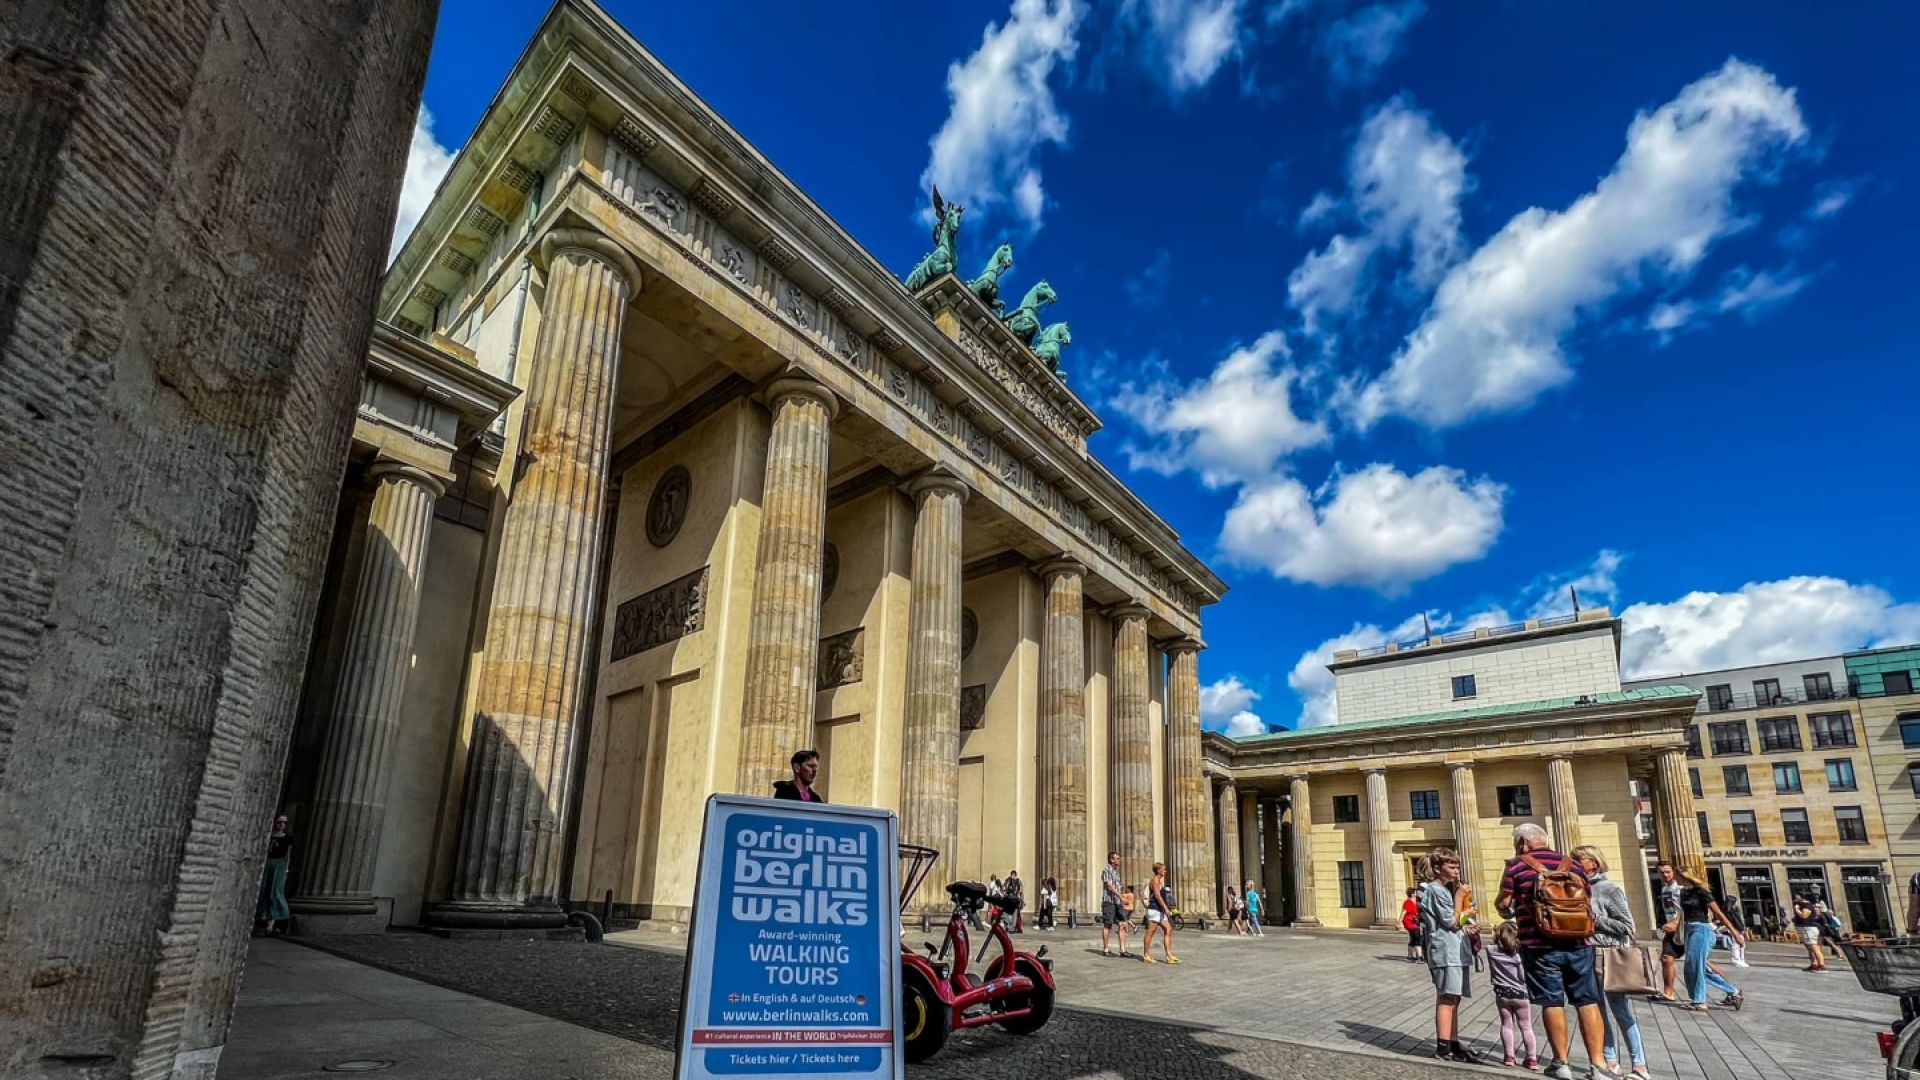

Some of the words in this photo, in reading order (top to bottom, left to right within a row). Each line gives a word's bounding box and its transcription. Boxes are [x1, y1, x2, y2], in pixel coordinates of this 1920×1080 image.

[737, 825, 867, 859] original
[734, 849, 867, 890] berlin
[732, 890, 868, 926] walks
[758, 929, 841, 944] Award-winning
[749, 943, 849, 963] WALKING
[765, 966, 838, 985] TOURS
[741, 993, 750, 1002] In
[753, 993, 788, 1005] English
[790, 993, 797, 1003] &
[800, 994, 814, 1003] auf
[818, 994, 855, 1003] Deutsch
[723, 1008, 868, 1021] www.berlinwalks.com
[772, 1031, 781, 1041] IN
[784, 1031, 802, 1041] THE
[804, 1031, 836, 1041] WORLD
[730, 1054, 767, 1064] Tickets
[770, 1054, 790, 1063] hier
[792, 1054, 798, 1064] /
[801, 1053, 835, 1063] Tickets
[838, 1053, 860, 1063] here
